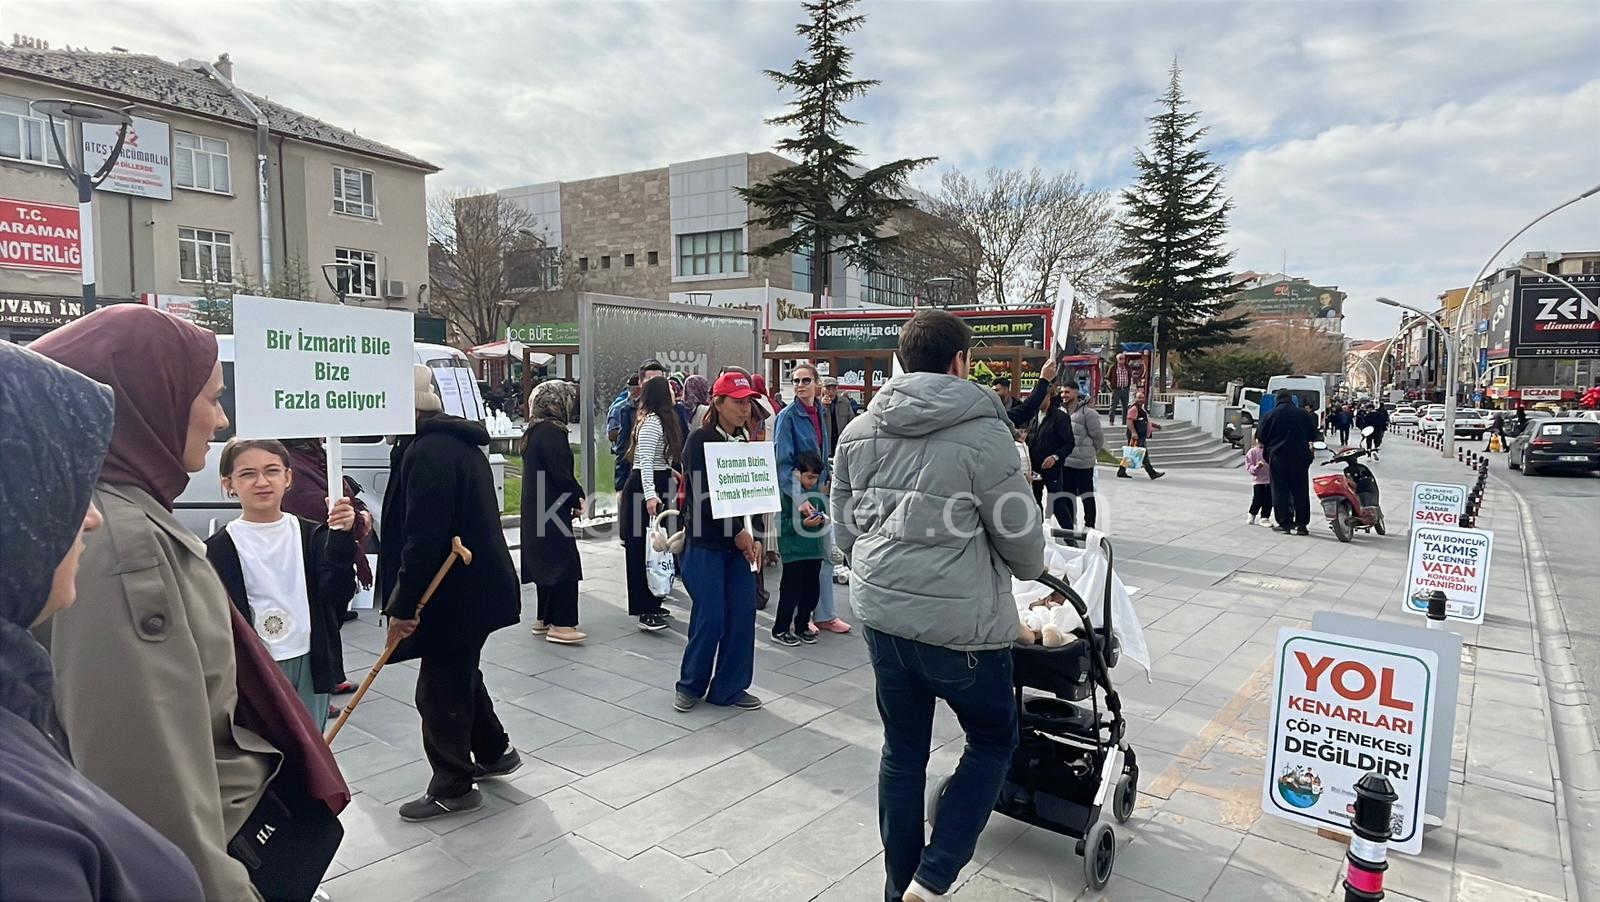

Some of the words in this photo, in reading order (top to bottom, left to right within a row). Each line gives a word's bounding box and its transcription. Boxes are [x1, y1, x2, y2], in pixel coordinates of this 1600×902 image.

[16, 207, 48, 221] T.C.
[0, 221, 78, 240] ARAMAN
[529, 325, 553, 341] BÜFE
[818, 325, 883, 337] ÖĞRETMENLER
[1543, 321, 1595, 330] diamond
[267, 330, 292, 350] Bir
[298, 328, 356, 354] İzmarit
[361, 337, 390, 355] Bile
[315, 362, 350, 381] Bize
[274, 390, 320, 409] Fazla
[326, 391, 386, 411] Geliyor!
[1523, 389, 1560, 397] ECZANE
[716, 457, 746, 469] Karaman
[718, 472, 750, 485] Şehrimizi
[751, 471, 770, 483] Temiz
[715, 489, 741, 501] Tutmak
[1444, 535, 1486, 547] BONCUK
[1424, 542, 1478, 558] TAKMIŞ
[1437, 555, 1477, 566] CENNET
[1422, 561, 1476, 577] VATAN
[1416, 578, 1477, 593] UTANIRDIK!
[1293, 650, 1414, 712] YOL
[1288, 695, 1414, 735] KENARLARI
[1285, 718, 1322, 735] ÇÖP
